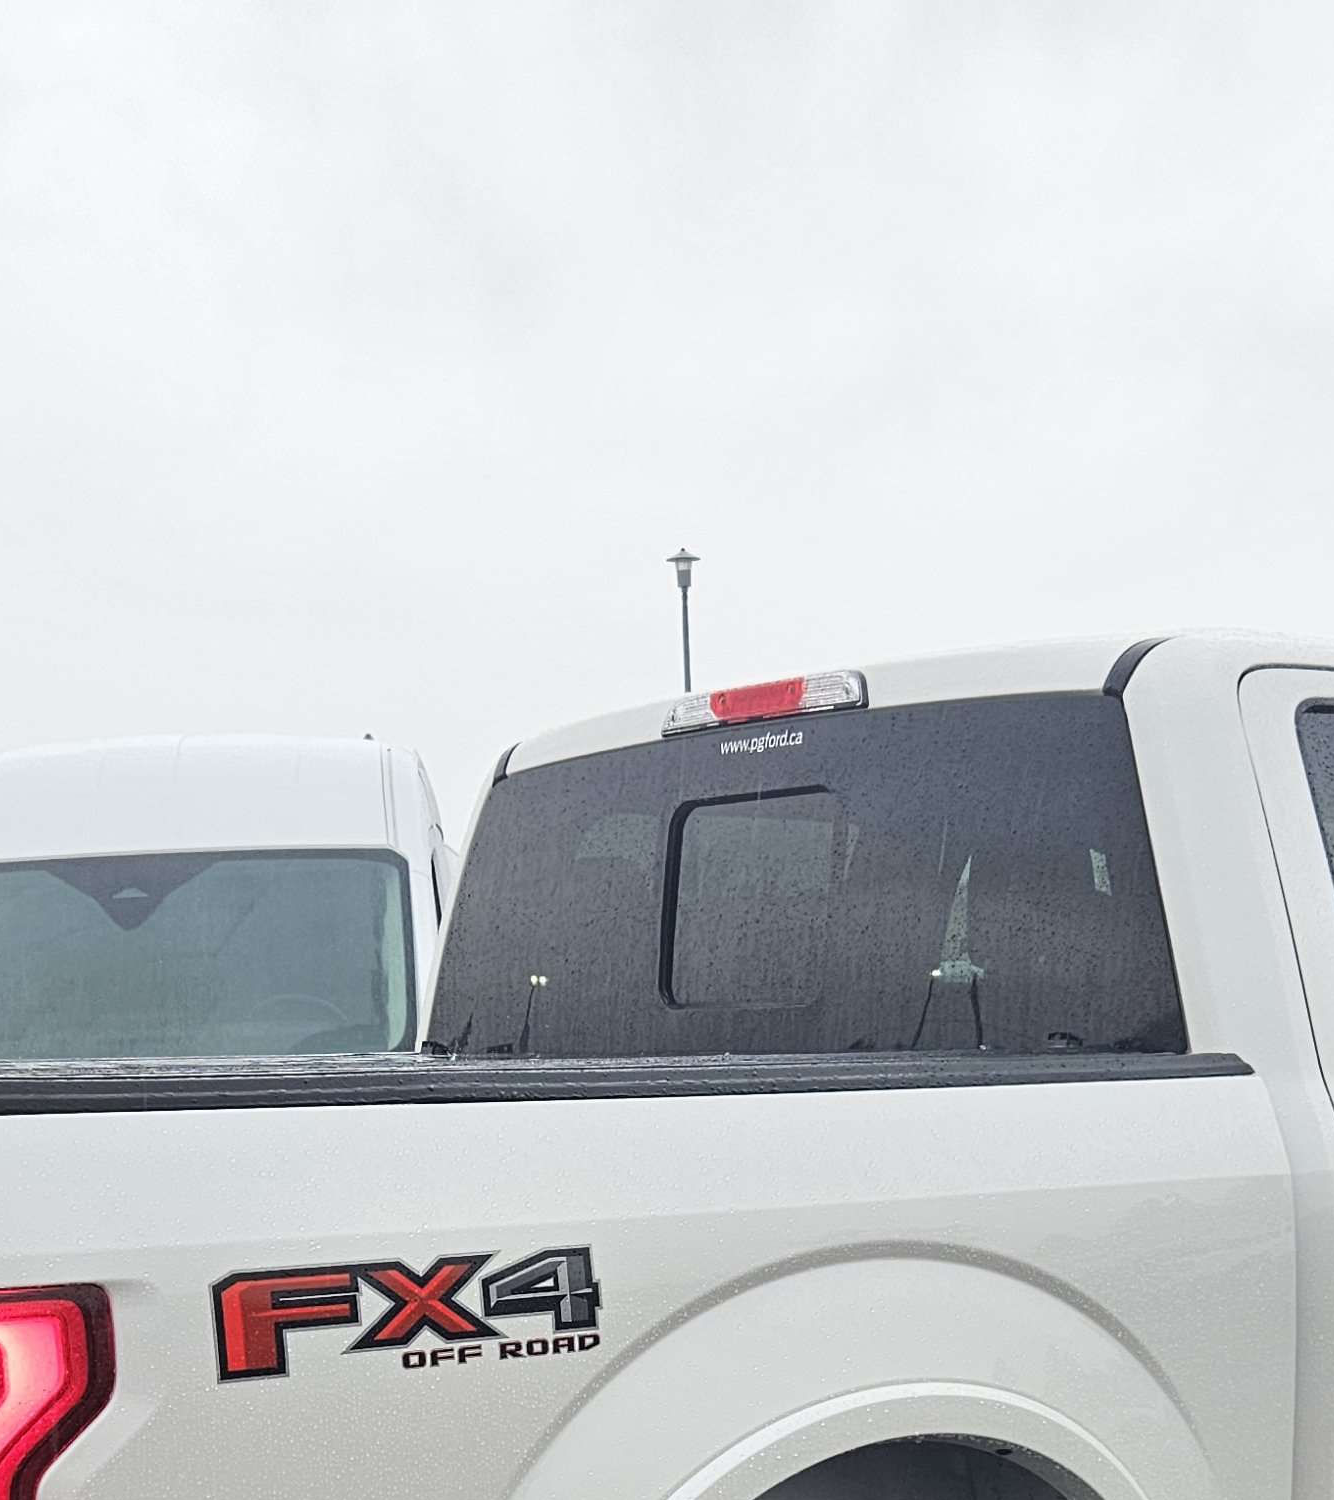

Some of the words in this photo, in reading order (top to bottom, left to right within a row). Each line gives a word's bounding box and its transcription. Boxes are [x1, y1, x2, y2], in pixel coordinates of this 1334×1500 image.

[720, 729, 803, 755] www.pgford.ca
[208, 1244, 603, 1384] FX4
[401, 1344, 483, 1370] OFF
[498, 1333, 602, 1361] ROAD
